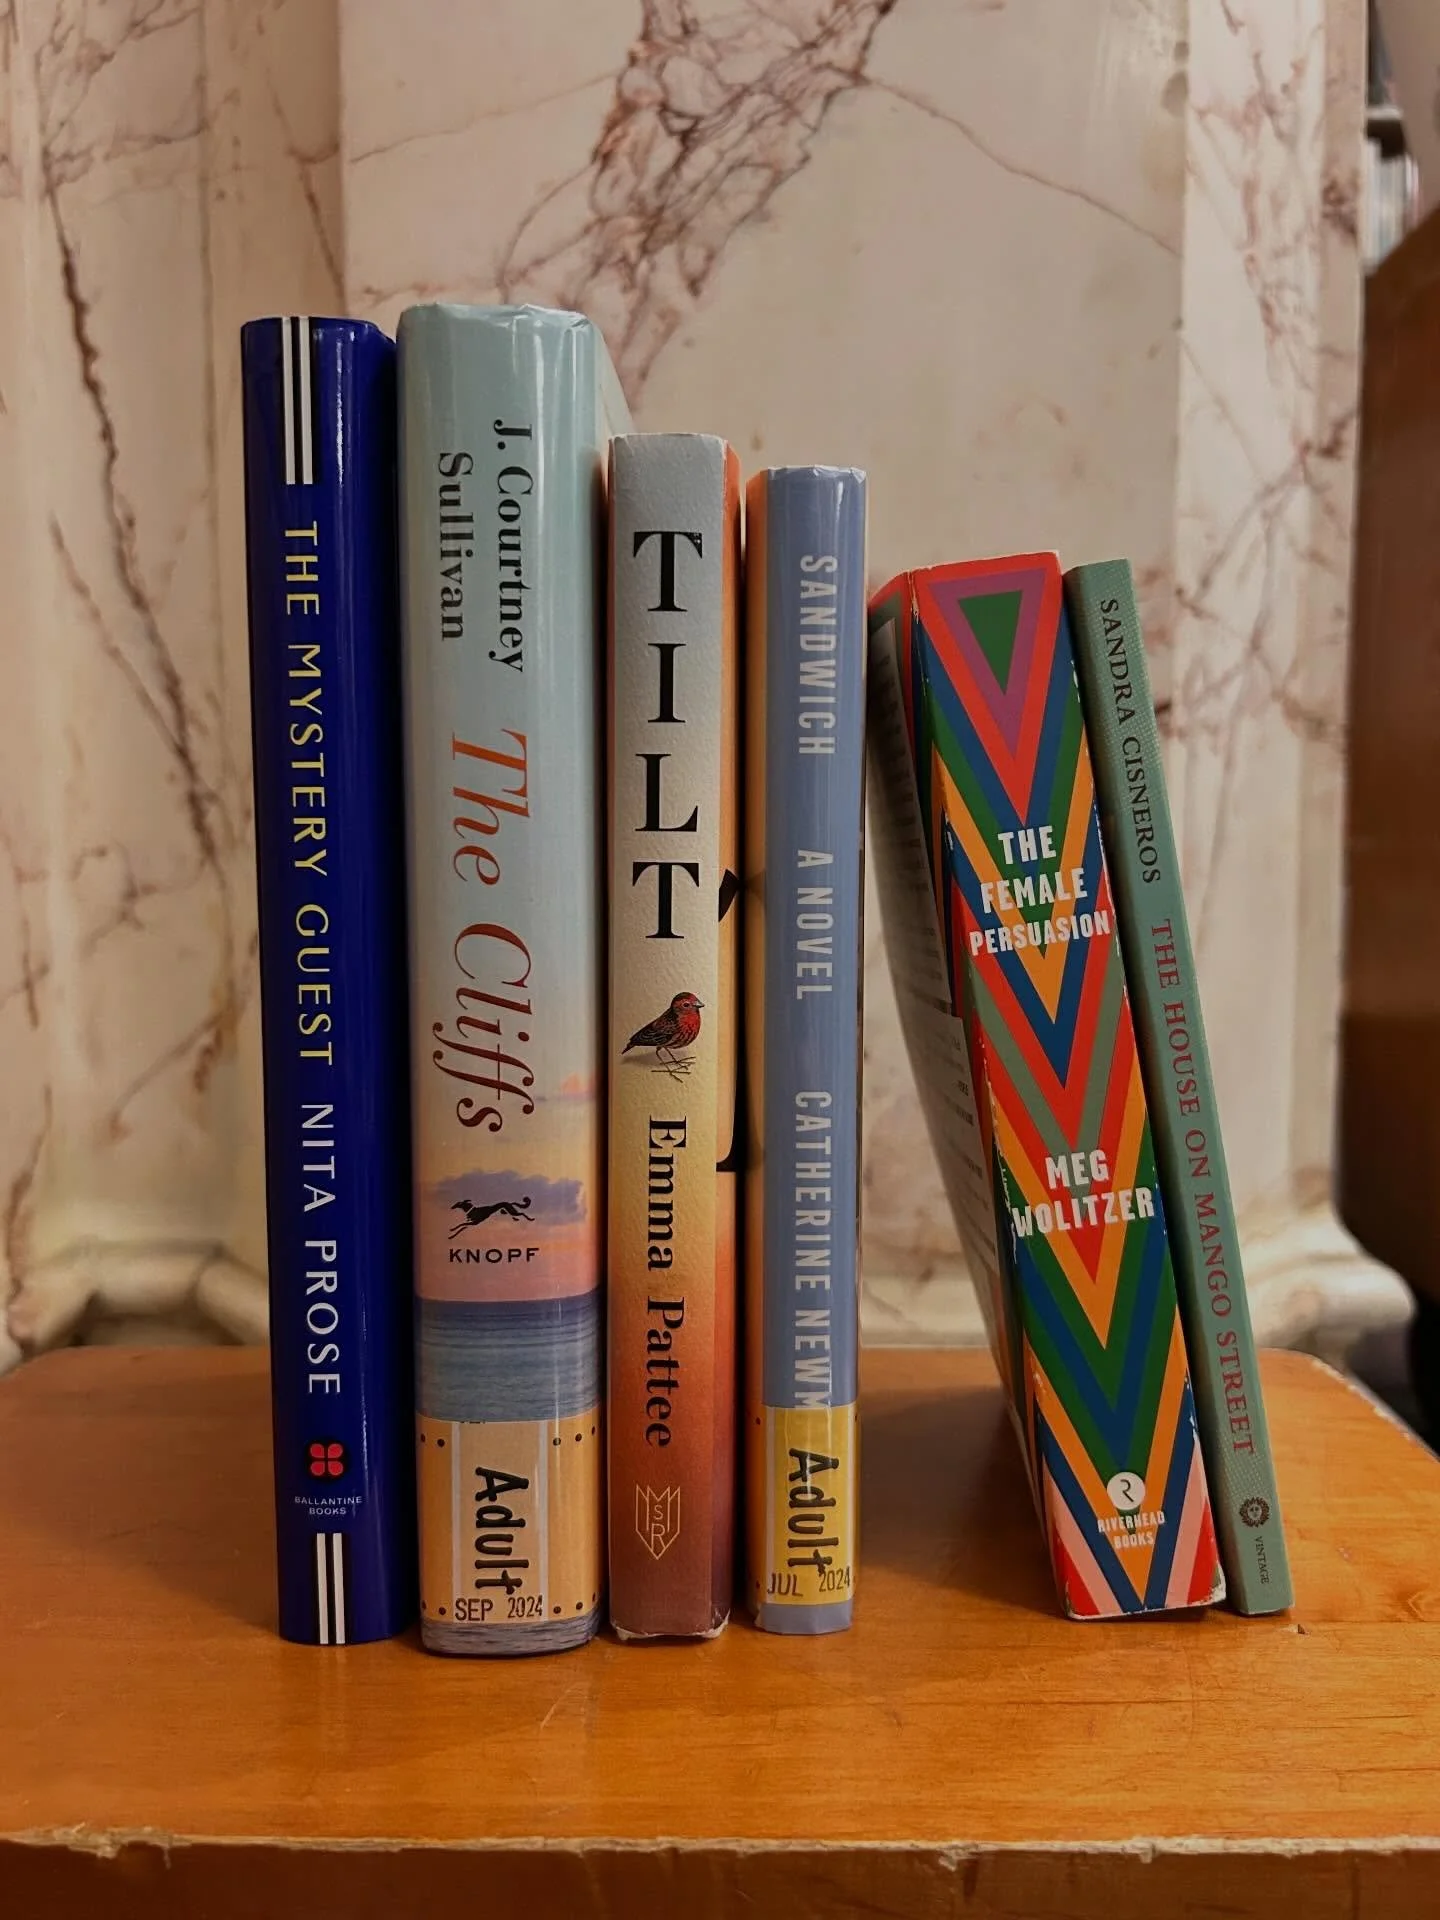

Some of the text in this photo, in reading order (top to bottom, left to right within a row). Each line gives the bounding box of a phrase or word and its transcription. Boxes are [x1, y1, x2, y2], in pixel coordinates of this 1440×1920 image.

[438, 452, 474, 641] Sullivan
[488, 419, 534, 672] J. Courtney
[799, 554, 838, 755] SANDWICH
[285, 520, 333, 1066] THE MYSTERY GUEST
[632, 530, 703, 939] TILT
[1101, 598, 1162, 885] SANDRA CISNEROS
[980, 867, 1088, 914] FEMALE
[998, 825, 1057, 865] THE
[432, 728, 535, 1132] The Cliffs
[795, 849, 834, 1000] A NOVEL
[969, 910, 1111, 957] PERSUASION
[794, 1090, 833, 1291] CATHERINE
[1012, 1187, 1154, 1238] WOLITZER
[1045, 1149, 1109, 1189] MEG
[1151, 918, 1255, 1455] THE HOUSE ON MANGO STREET
[301, 1103, 342, 1395] NITA PROSE
[449, 1247, 540, 1264] KNOPF
[646, 1114, 688, 1448] Emma Pattee
[294, 1495, 363, 1505] BALLANTINE
[309, 1506, 347, 1515] BOOKS
[474, 1465, 530, 1595] Adult
[788, 1447, 840, 1574] Adult
[1097, 1510, 1166, 1533] RIVERHEAD
[1113, 1531, 1154, 1549] BOOKS
[1253, 1535, 1271, 1585] VINTAGE
[454, 1594, 544, 1622] SEP 2024
[767, 1565, 852, 1597] JUL 2024
